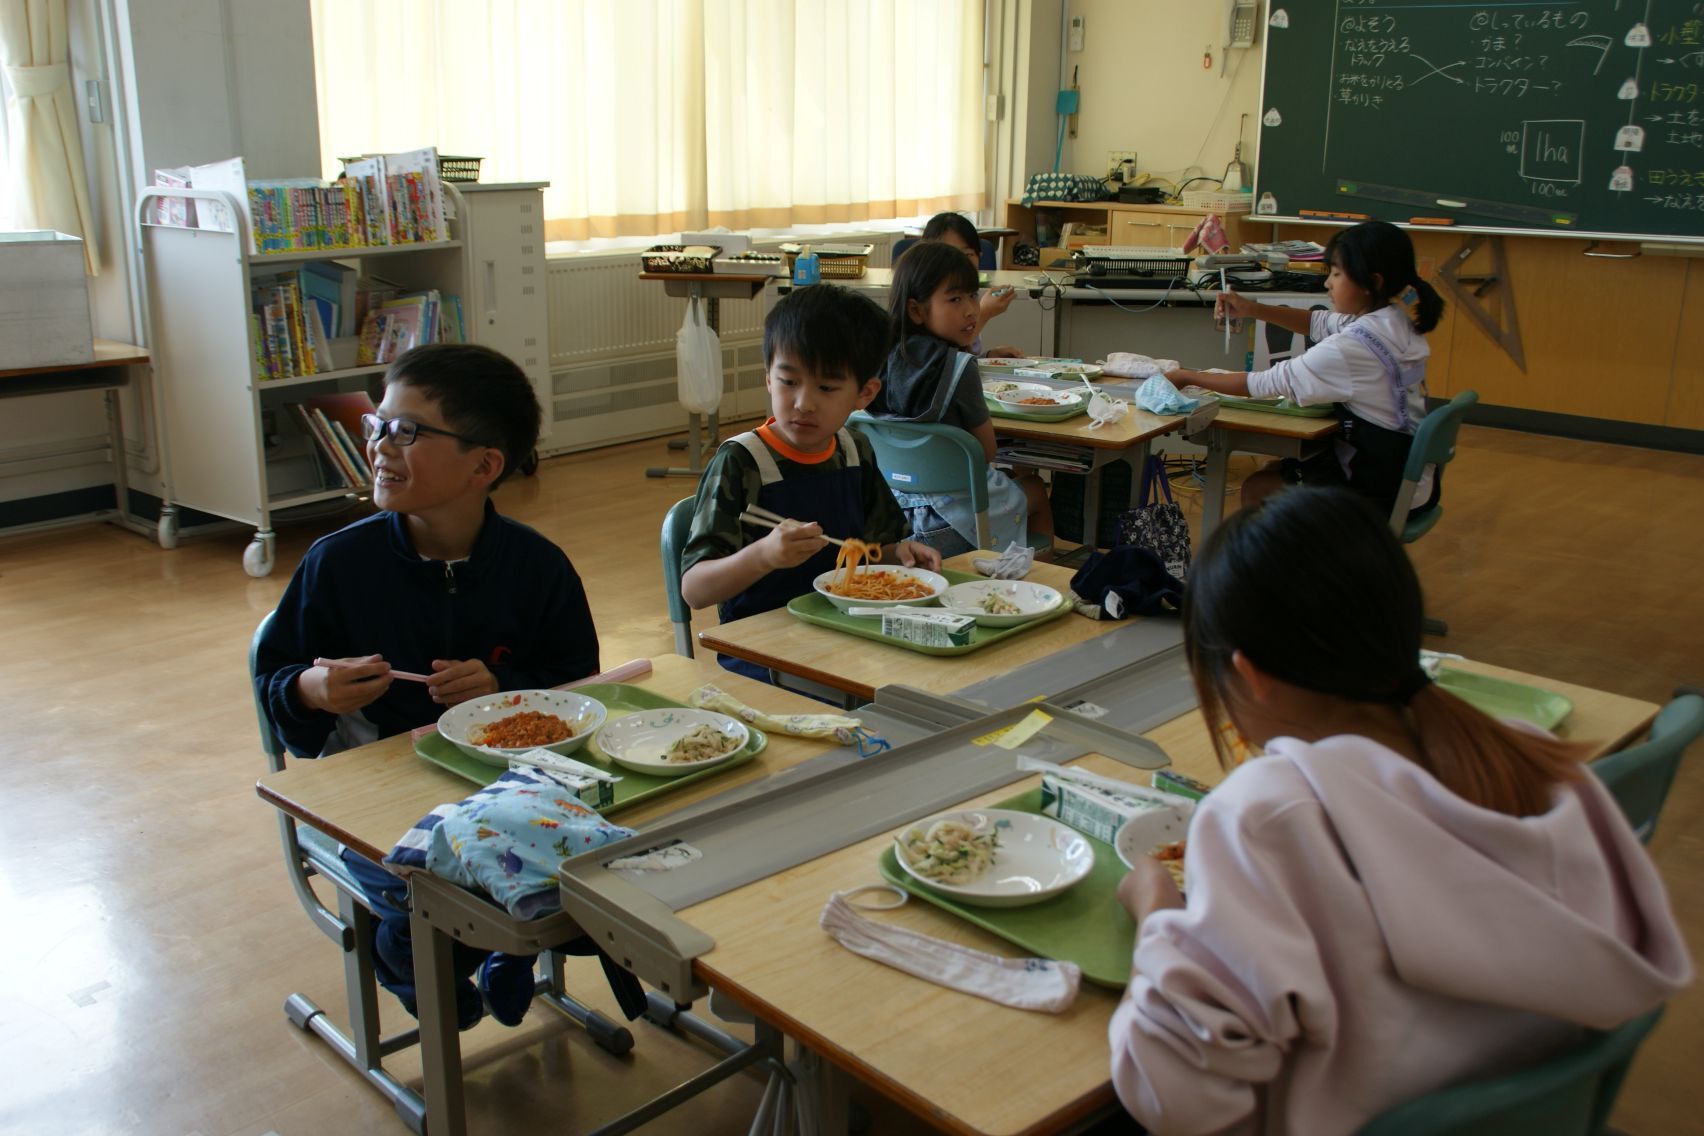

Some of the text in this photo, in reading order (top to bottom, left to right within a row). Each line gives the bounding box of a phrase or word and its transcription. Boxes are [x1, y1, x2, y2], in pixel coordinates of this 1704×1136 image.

[1351, 53, 1385, 67] トラック
[1500, 131, 1519, 142] 100
[1536, 131, 1569, 164] 1ha
